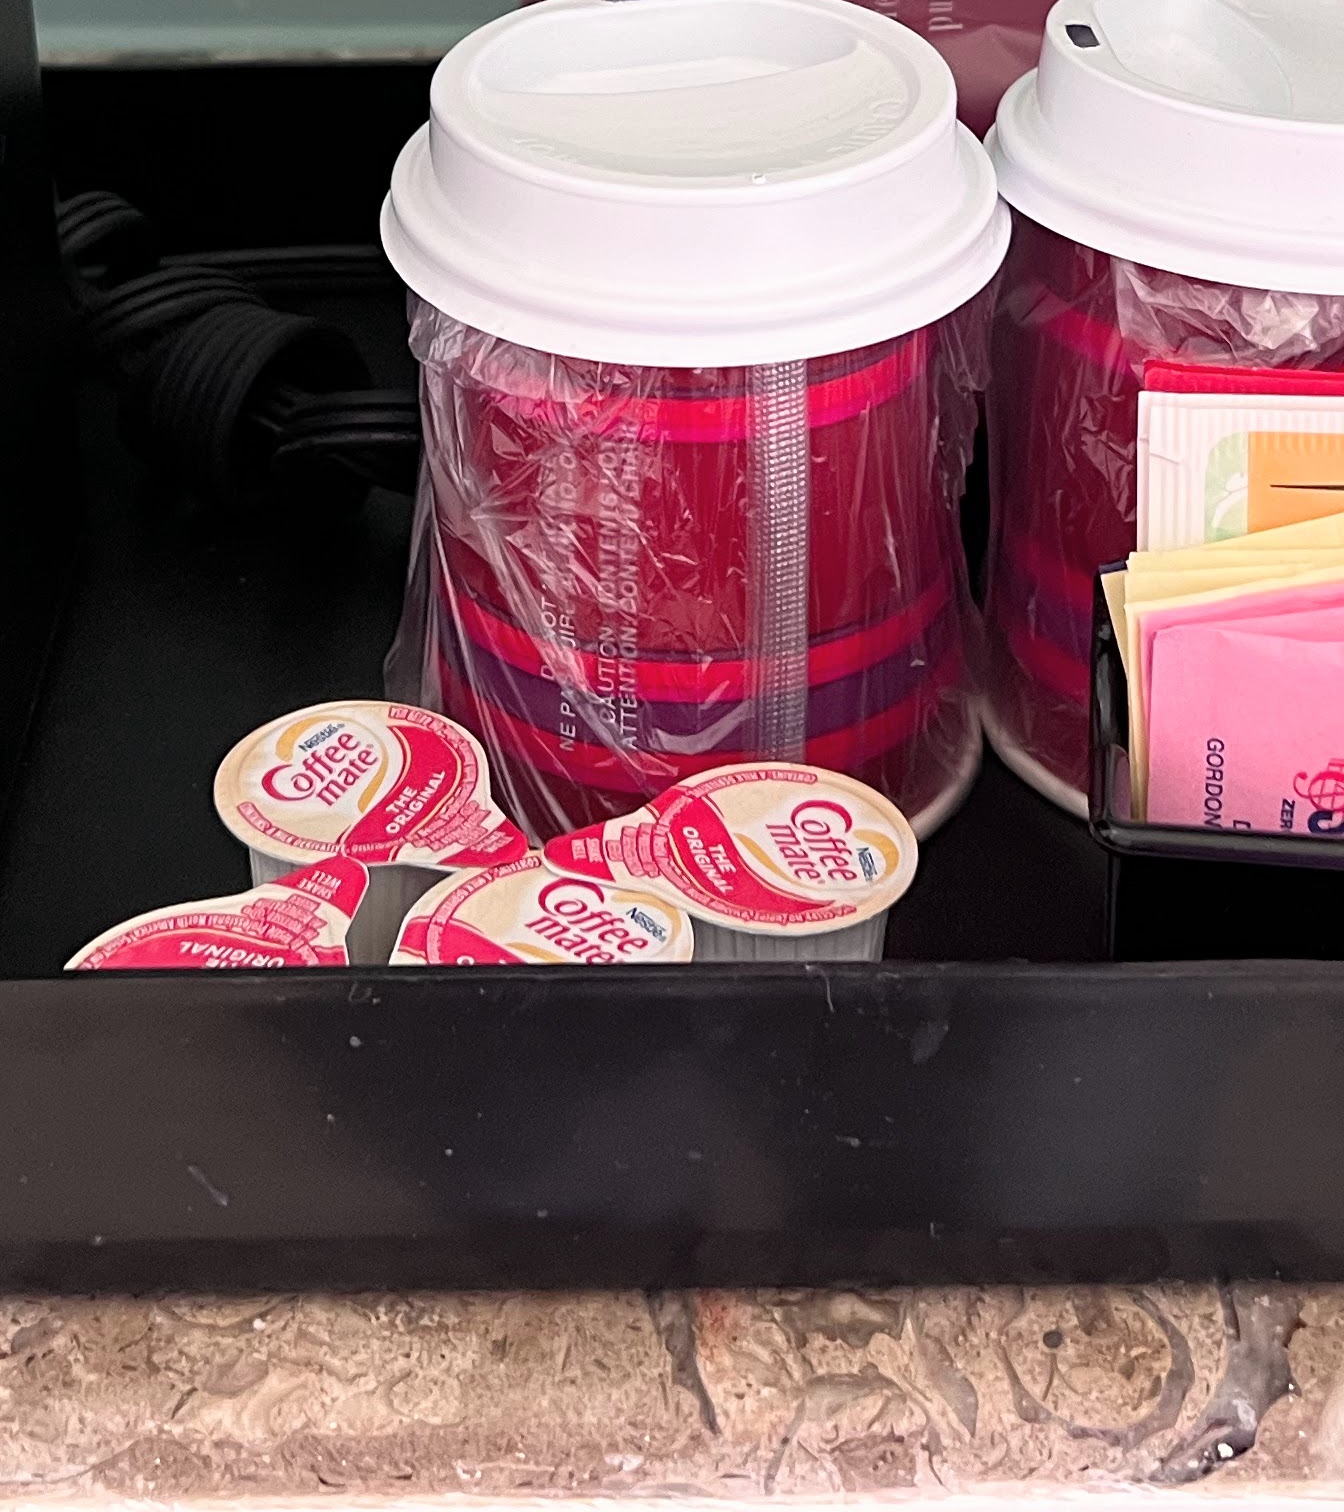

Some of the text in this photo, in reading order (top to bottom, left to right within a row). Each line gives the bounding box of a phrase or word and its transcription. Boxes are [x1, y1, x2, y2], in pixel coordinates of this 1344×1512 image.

[261, 731, 361, 801] Coffee
[385, 785, 419, 814] THE
[385, 770, 446, 835] ORIGINAL
[682, 825, 735, 896] ORIGINAL
[709, 842, 736, 875] THE
[790, 799, 858, 883] Coffee
[309, 869, 343, 892] WELL
[538, 877, 648, 955] Coffee
